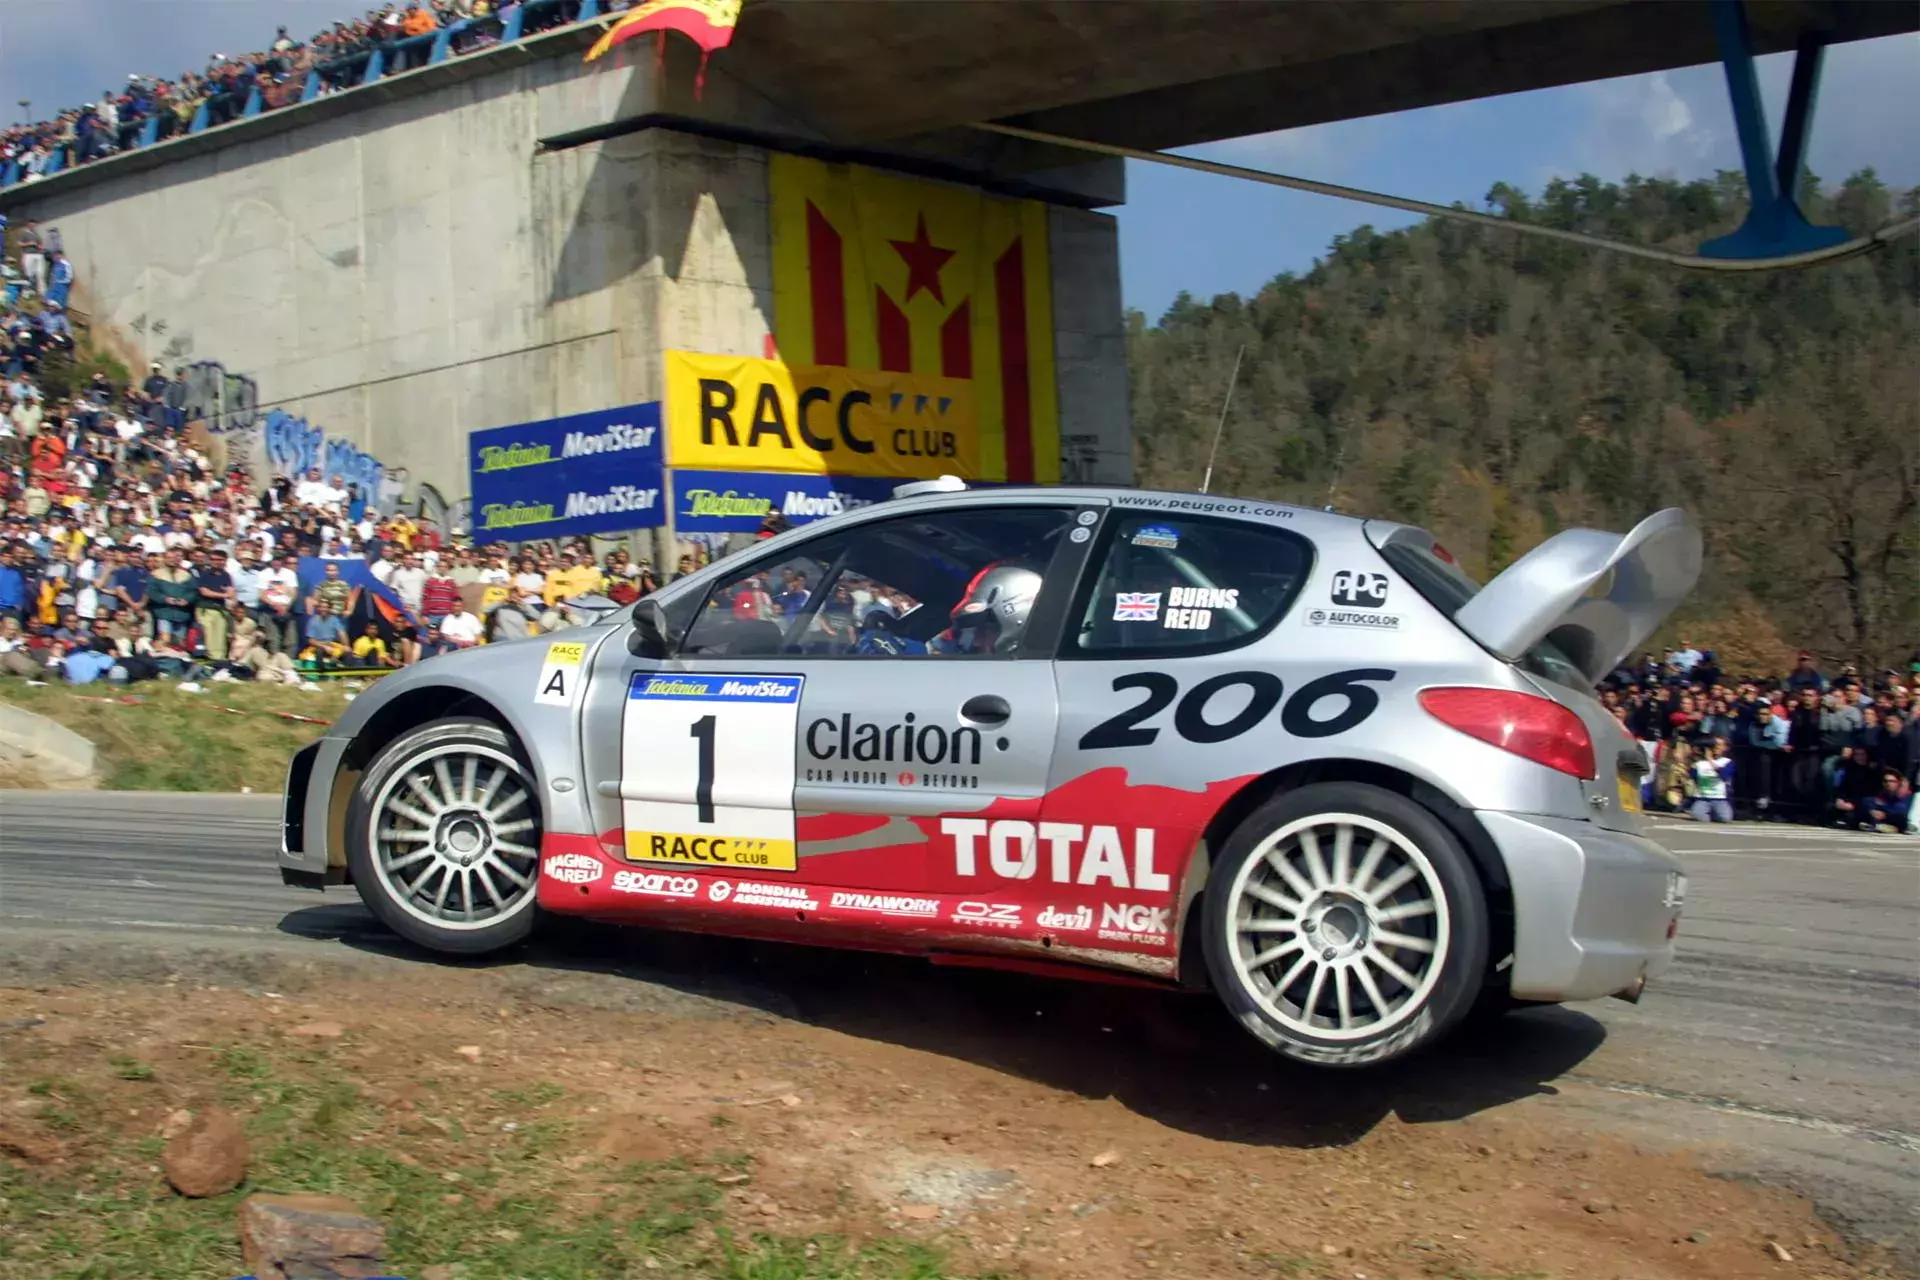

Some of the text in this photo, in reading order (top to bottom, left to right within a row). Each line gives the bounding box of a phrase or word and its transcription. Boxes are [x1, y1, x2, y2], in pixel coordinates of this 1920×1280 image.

[698, 377, 956, 458] RACC CLUB
[562, 424, 656, 459] MoviStar
[565, 485, 659, 519] MoviStar
[1118, 495, 1295, 520] www.peugeot.com
[1168, 586, 1240, 610] BURNS
[1331, 570, 1388, 602] PPG
[1164, 609, 1212, 631] REID
[1329, 612, 1400, 626] AUTOCOLOR
[551, 646, 581, 656] RACC
[543, 668, 566, 697] A
[719, 681, 796, 698] MoviStar
[1078, 668, 1397, 750] 206
[690, 714, 718, 824] 1
[806, 768, 979, 789] CAR AUDIO BEYOND
[651, 835, 769, 865] RACC CLUB
[941, 817, 1170, 892] TOTAL
[613, 869, 699, 894] sparco
[736, 881, 808, 899] MONDIAL
[732, 893, 819, 911] ASSISTANCE
[832, 892, 940, 912] DYNAWORK
[1036, 904, 1093, 929] devil
[1100, 902, 1171, 934] NGK
[1098, 929, 1166, 946] SPARK PLUGS
